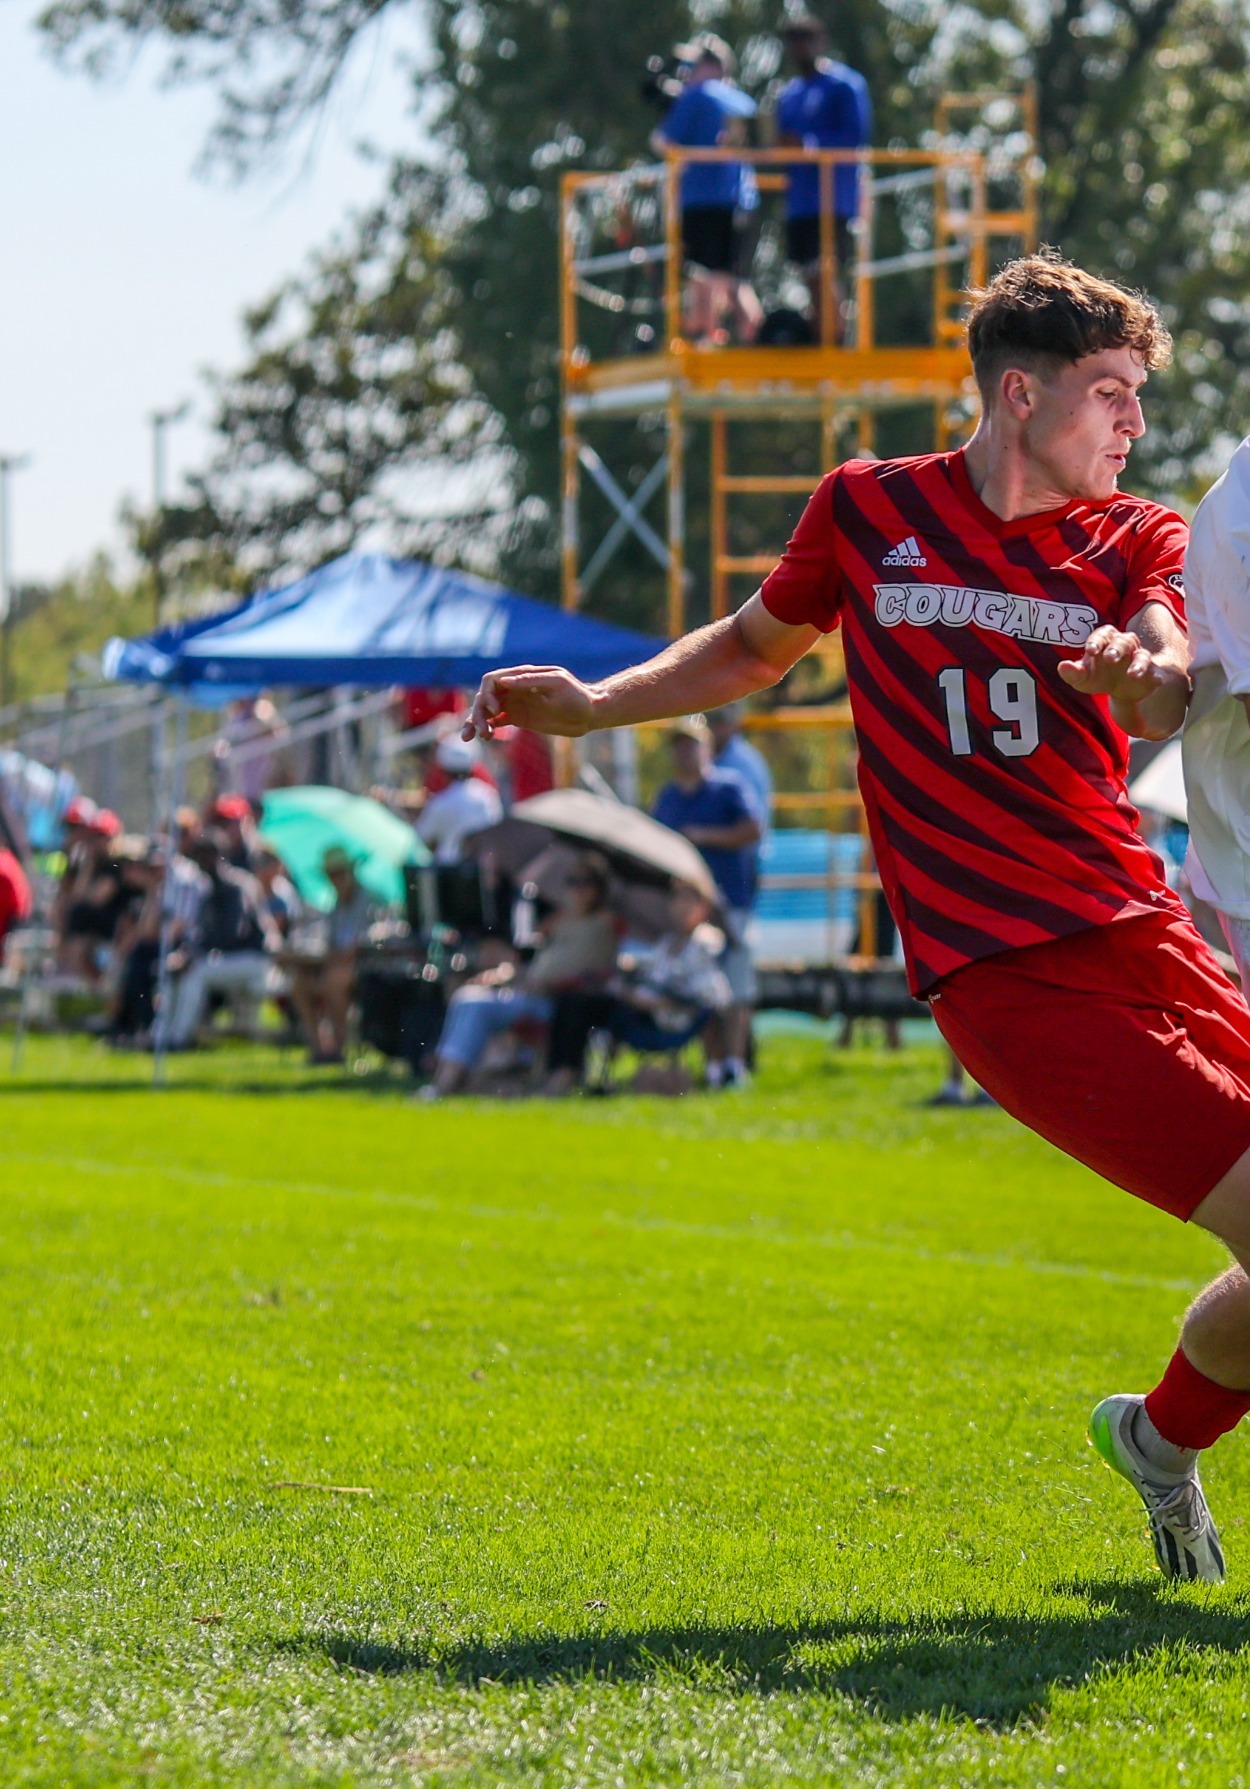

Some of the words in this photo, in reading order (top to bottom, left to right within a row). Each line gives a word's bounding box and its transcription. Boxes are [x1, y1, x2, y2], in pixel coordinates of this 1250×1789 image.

[882, 555, 927, 568] adidas
[872, 583, 1098, 648] COUGARS
[937, 667, 1040, 758] 19
